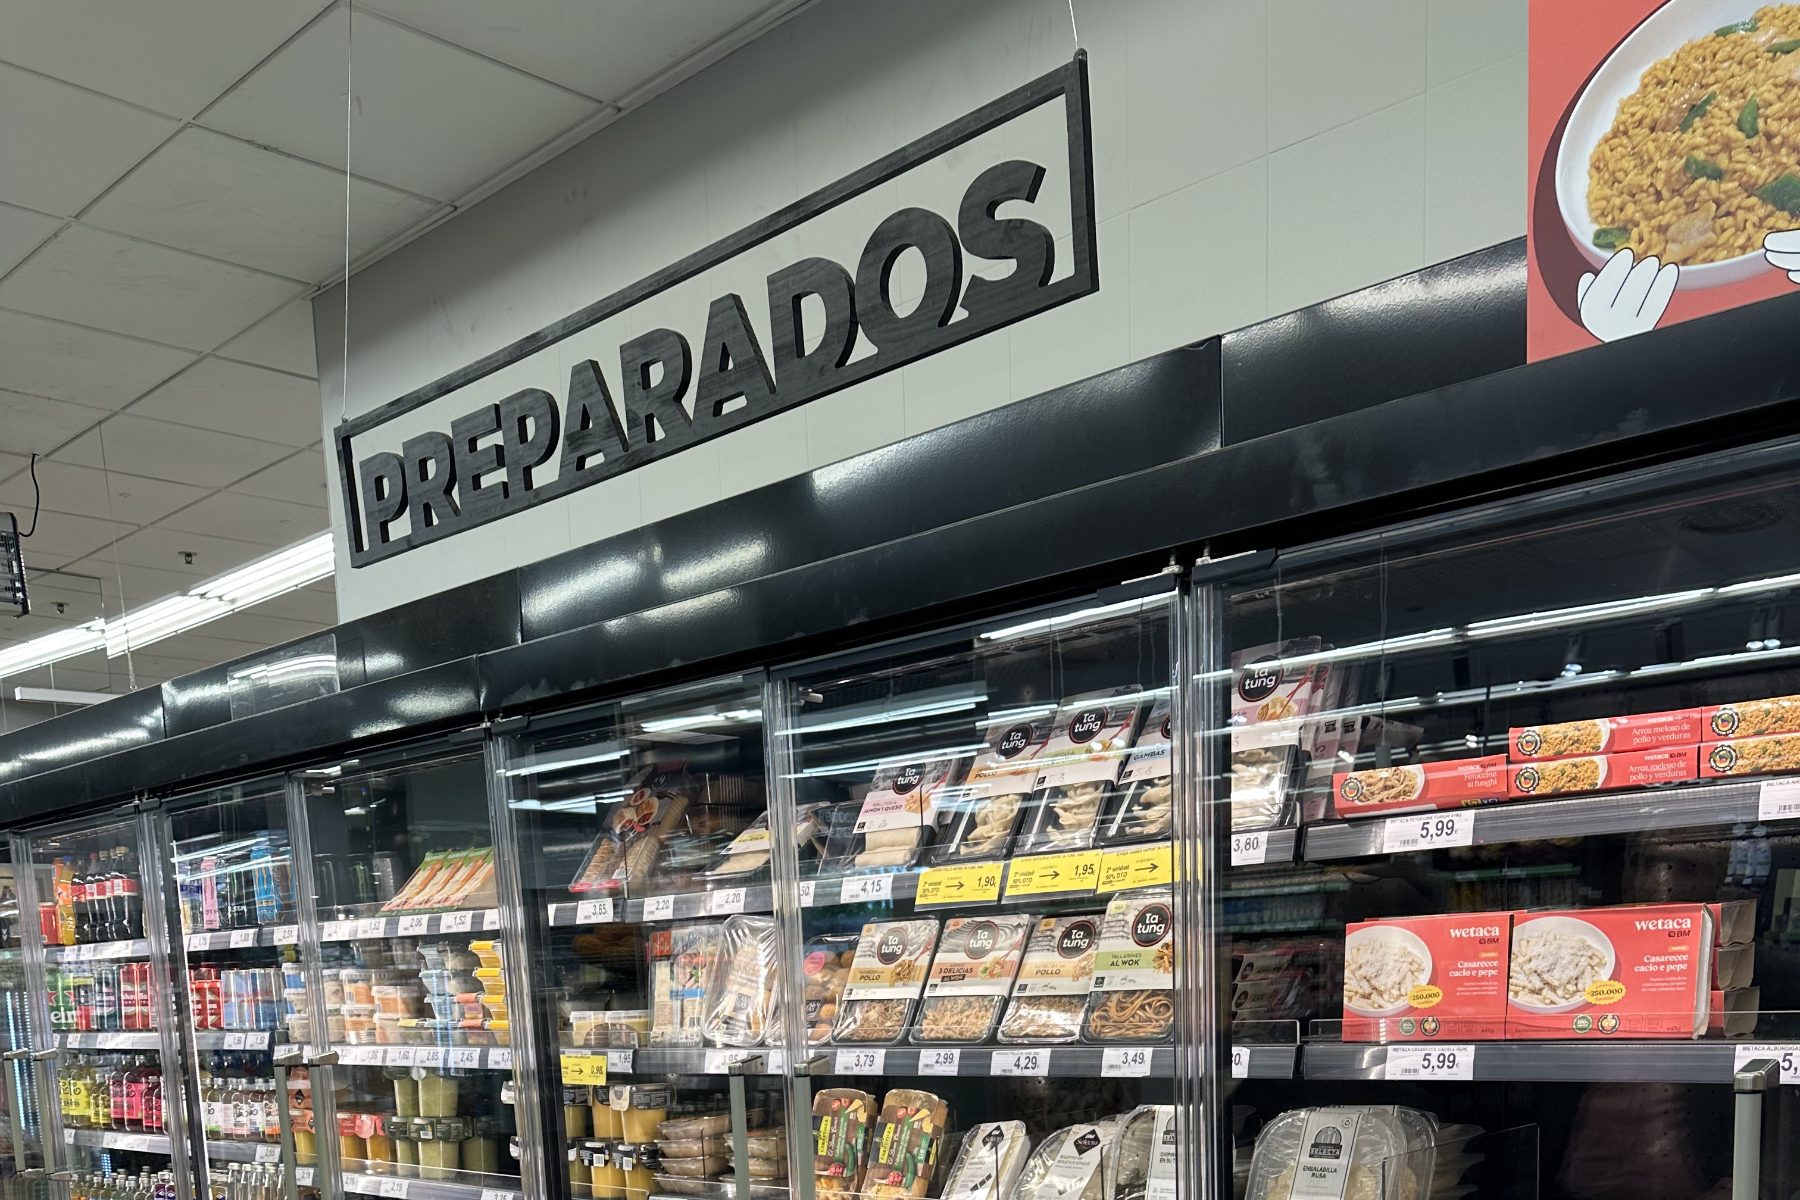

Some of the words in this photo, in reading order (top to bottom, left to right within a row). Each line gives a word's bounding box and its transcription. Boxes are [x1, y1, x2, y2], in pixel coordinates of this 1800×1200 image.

[359, 159, 1056, 552] PREPARADOS
[1245, 676, 1276, 690] tung
[1074, 720, 1101, 732] tung
[1658, 732, 1691, 742] verduras
[1001, 738, 1027, 748] tung
[897, 774, 919, 785] tung
[1138, 923, 1165, 935] tung
[1635, 918, 1691, 931] wetaca
[1449, 926, 1500, 939] wetaca
[1677, 930, 1690, 938] BM
[970, 939, 992, 949] tung
[1063, 937, 1088, 948] tung
[882, 942, 902, 954] tung
[1110, 959, 1121, 967] AL
[1124, 958, 1141, 966] WOK
[1644, 953, 1689, 962] Casarecce
[1457, 960, 1498, 968] Casarecce
[1634, 964, 1658, 972] cacio
[1666, 963, 1688, 973] pepe
[1449, 969, 1471, 977] cacio
[1478, 969, 1498, 978] pepe
